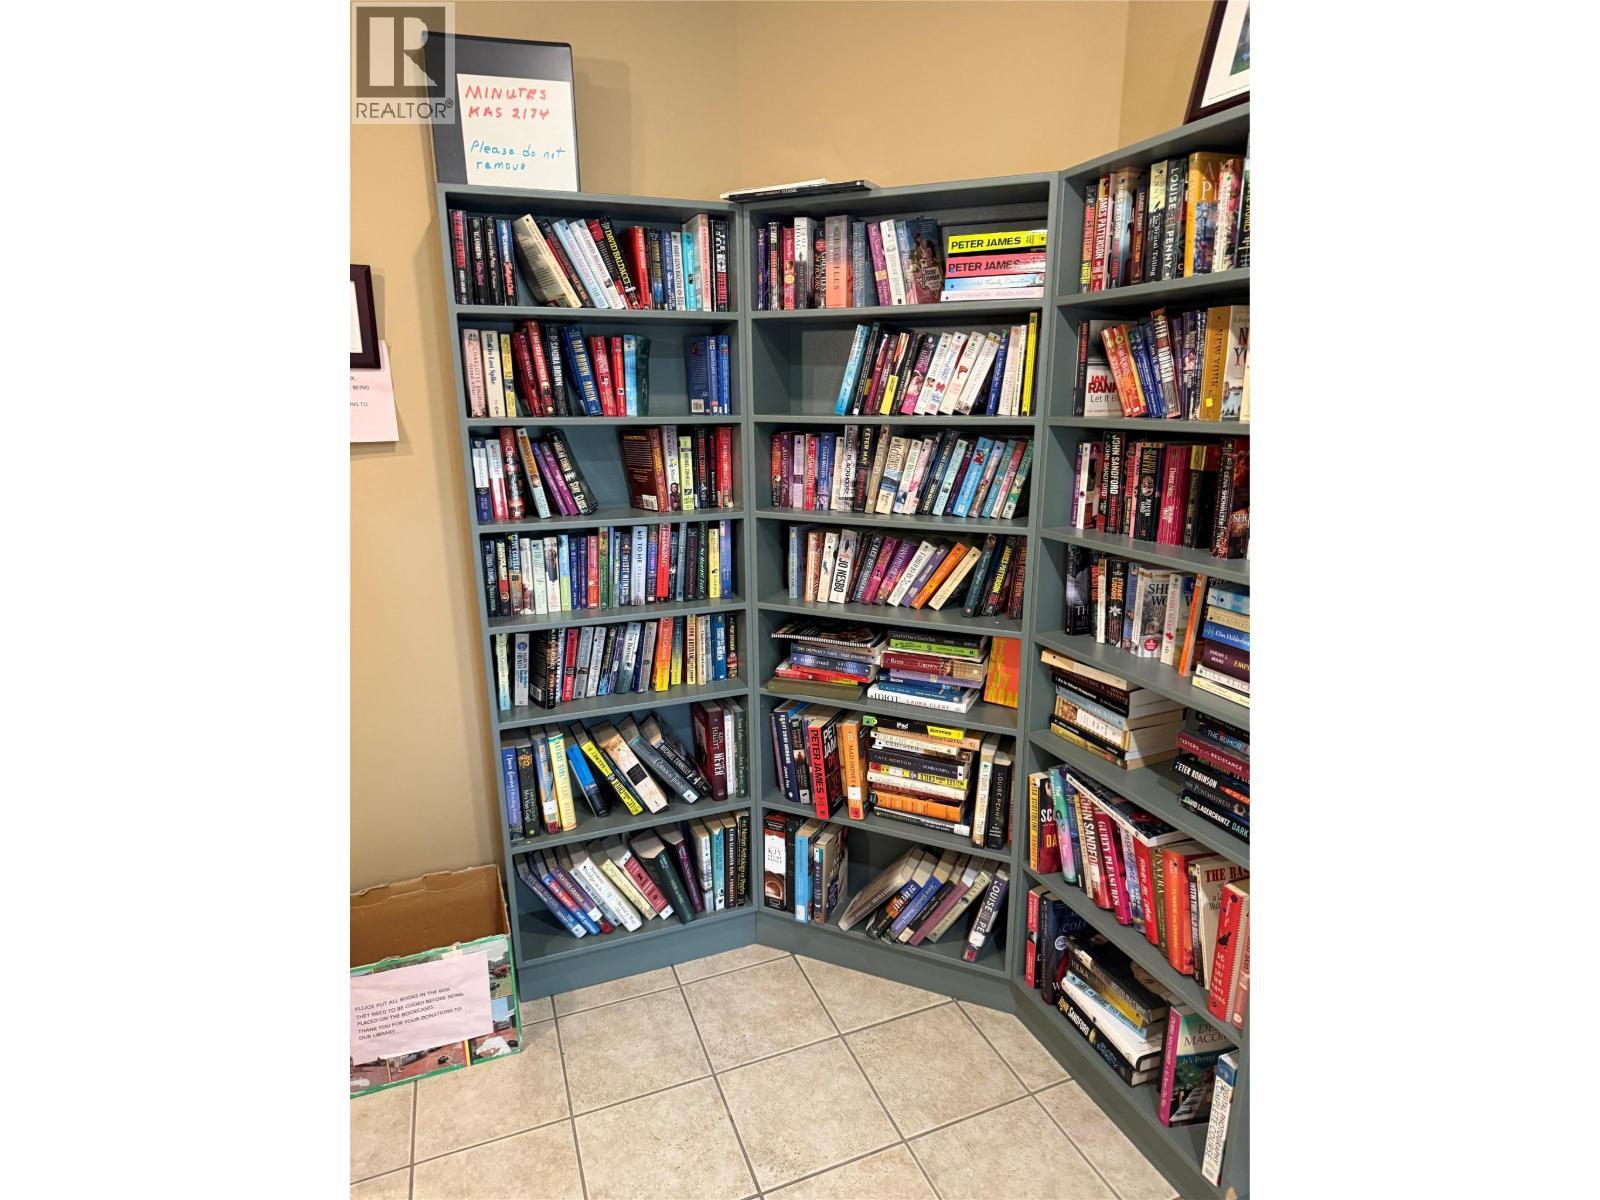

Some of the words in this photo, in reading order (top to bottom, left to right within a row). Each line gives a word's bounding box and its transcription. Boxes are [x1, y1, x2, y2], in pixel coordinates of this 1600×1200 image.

[465, 85, 547, 100] MINUTES
[468, 106, 502, 119] KAS
[512, 107, 550, 120] 2174
[470, 140, 516, 156] Please
[522, 144, 536, 158] do
[543, 147, 566, 160] not
[476, 162, 526, 171] remove
[1168, 168, 1180, 211] LOUISE
[1114, 203, 1123, 240] PATTERSON
[951, 240, 983, 250] PETER
[985, 236, 1021, 247] JAMES
[1083, 227, 1094, 261] PATTERSON
[1096, 218, 1107, 260] PATTERSON
[1152, 226, 1160, 250] Brutal
[1163, 230, 1175, 268] PENNY
[605, 229, 618, 250] DAVID
[613, 250, 630, 285] BALDACCI
[948, 261, 982, 272] PETER
[984, 259, 1020, 270] JAMES
[1150, 250, 1159, 277] Telling
[814, 263, 822, 290] HOURS
[833, 265, 841, 290] ILES
[1154, 317, 1166, 339] PETER
[549, 342, 560, 364] SANDRA
[572, 339, 583, 352] DAN
[1213, 328, 1224, 355] NEW
[553, 365, 563, 386] BROWN
[576, 354, 590, 377] BROWN
[1158, 346, 1173, 382] ROBINSON
[1210, 358, 1221, 389] YORK
[584, 380, 597, 401] ORIGIN
[1090, 395, 1102, 403] Let
[1111, 435, 1120, 456] JOHN
[506, 446, 517, 474] Cleeves
[1141, 449, 1150, 474] SMITH
[844, 454, 853, 495] BLACKHOUSE
[1101, 461, 1110, 497] SANDFORD
[1109, 456, 1119, 495] SANDFORD
[575, 494, 588, 509] CLOSE
[1218, 489, 1228, 527] SHOWALTER
[637, 543, 643, 552] TO
[637, 554, 643, 564] ME
[1002, 546, 1012, 564] JAMES
[512, 550, 521, 574] CUSSLER
[838, 557, 849, 569] JO
[833, 569, 846, 593] NESBO
[992, 563, 1008, 594] PATTERSON
[1211, 657, 1225, 665] MAAS
[874, 692, 898, 702] IDIOT
[712, 727, 720, 750] FOLLETT
[929, 727, 952, 736] dummies
[1208, 729, 1219, 740] THE
[1219, 735, 1242, 750] RUMOR
[811, 729, 820, 760] PETER
[848, 745, 856, 760] MAD
[1179, 737, 1199, 751] SISTERS
[1210, 752, 1243, 771] RESISTANCE
[674, 759, 692, 775] CONNELLY
[713, 752, 725, 776] NEVER
[888, 757, 912, 766] MORTON
[814, 762, 823, 794] JAMES
[1174, 762, 1191, 776] PETER
[1191, 768, 1218, 789] ROBINSON
[1080, 794, 1092, 821] JOHN
[1193, 783, 1231, 809] POSTMISTRESS
[523, 810, 534, 823] Gogh
[1183, 796, 1198, 809] DAVID
[1197, 803, 1231, 827] LAGERCRANTZ
[1231, 822, 1249, 838] DARK
[739, 828, 747, 846] Norton
[737, 846, 746, 873] Anthology
[1098, 821, 1111, 852] GUILTY
[1105, 856, 1120, 906] PLEASURES
[737, 878, 745, 895] Poetry
[1205, 869, 1226, 883] THE
[527, 874, 545, 891] STUART
[542, 891, 559, 908] WOODS
[569, 888, 584, 903] GRAHAM
[984, 880, 1003, 912] LOUISE
[1189, 882, 1198, 899] WITH
[1189, 899, 1197, 911] THE
[1189, 911, 1197, 926] OLD
[1171, 924, 1179, 949] DAWN
[1190, 926, 1198, 949] BREED
[354, 1004, 376, 1012] PLEASE
[400, 994, 419, 1002] BOOKS
[356, 1012, 370, 1020] THEY
[371, 1009, 387, 1017] NEED
[406, 1001, 425, 1010] CODED
[427, 997, 446, 1006] BEFORE
[447, 992, 465, 1001] BEING
[356, 1018, 379, 1027] PLACED
[358, 1026, 378, 1034] THANK
[404, 1017, 420, 1025] YOUR
[421, 1009, 453, 1021] DONATIONS
[1058, 997, 1069, 1014] JOHN
[1068, 1006, 1089, 1036] SANDFORD
[1169, 1016, 1177, 1035] DEBBIE
[358, 1033, 372, 1041] OUR
[1166, 1036, 1175, 1065] MACOMBER
[1210, 1079, 1222, 1125] COMPLETE
[1219, 1084, 1230, 1112] DIGITAL
[1205, 1125, 1218, 1160] COURSE
[1211, 1113, 1225, 1164] PHOTOGRAPHY
